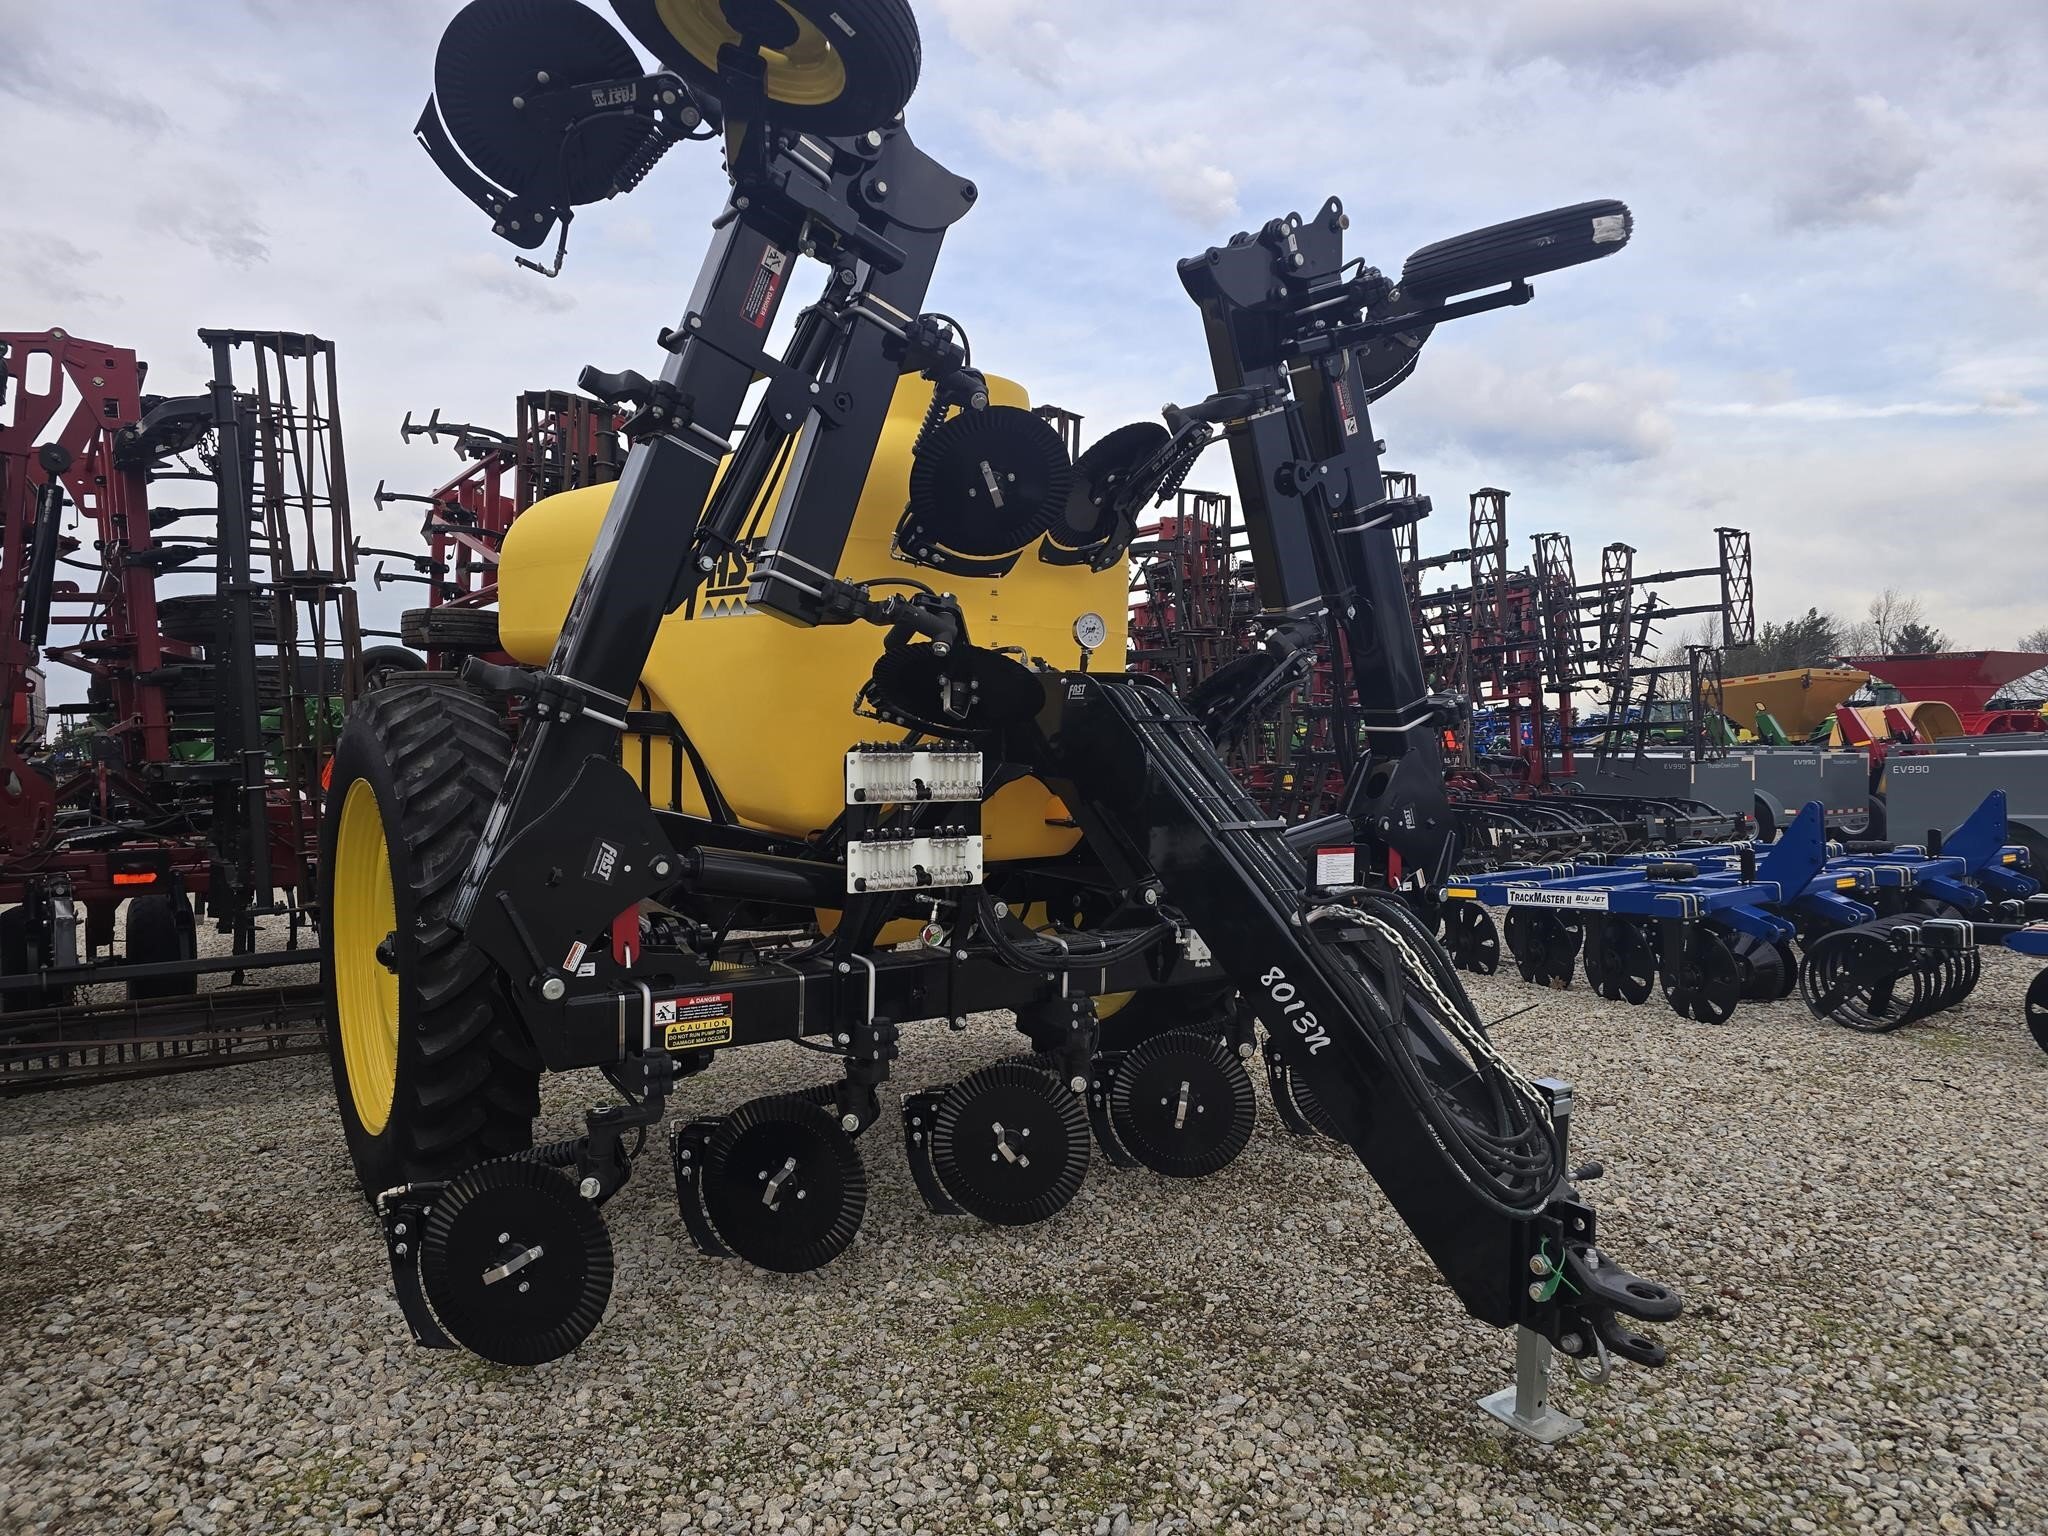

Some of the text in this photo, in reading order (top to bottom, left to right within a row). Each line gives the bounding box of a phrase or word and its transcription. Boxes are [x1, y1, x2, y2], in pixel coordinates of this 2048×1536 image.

[607, 82, 637, 105] FAST
[1067, 683, 1087, 700] FAST
[1892, 765, 1930, 775] EV990
[1403, 809, 1417, 830] FAST
[598, 841, 619, 881] FAST
[695, 995, 721, 1004] DANGER
[1259, 965, 1332, 1056] 8013N
[679, 1019, 728, 1032] CAUTION
[701, 1029, 716, 1037] PUMP
[672, 1038, 695, 1046] DAMAGE
